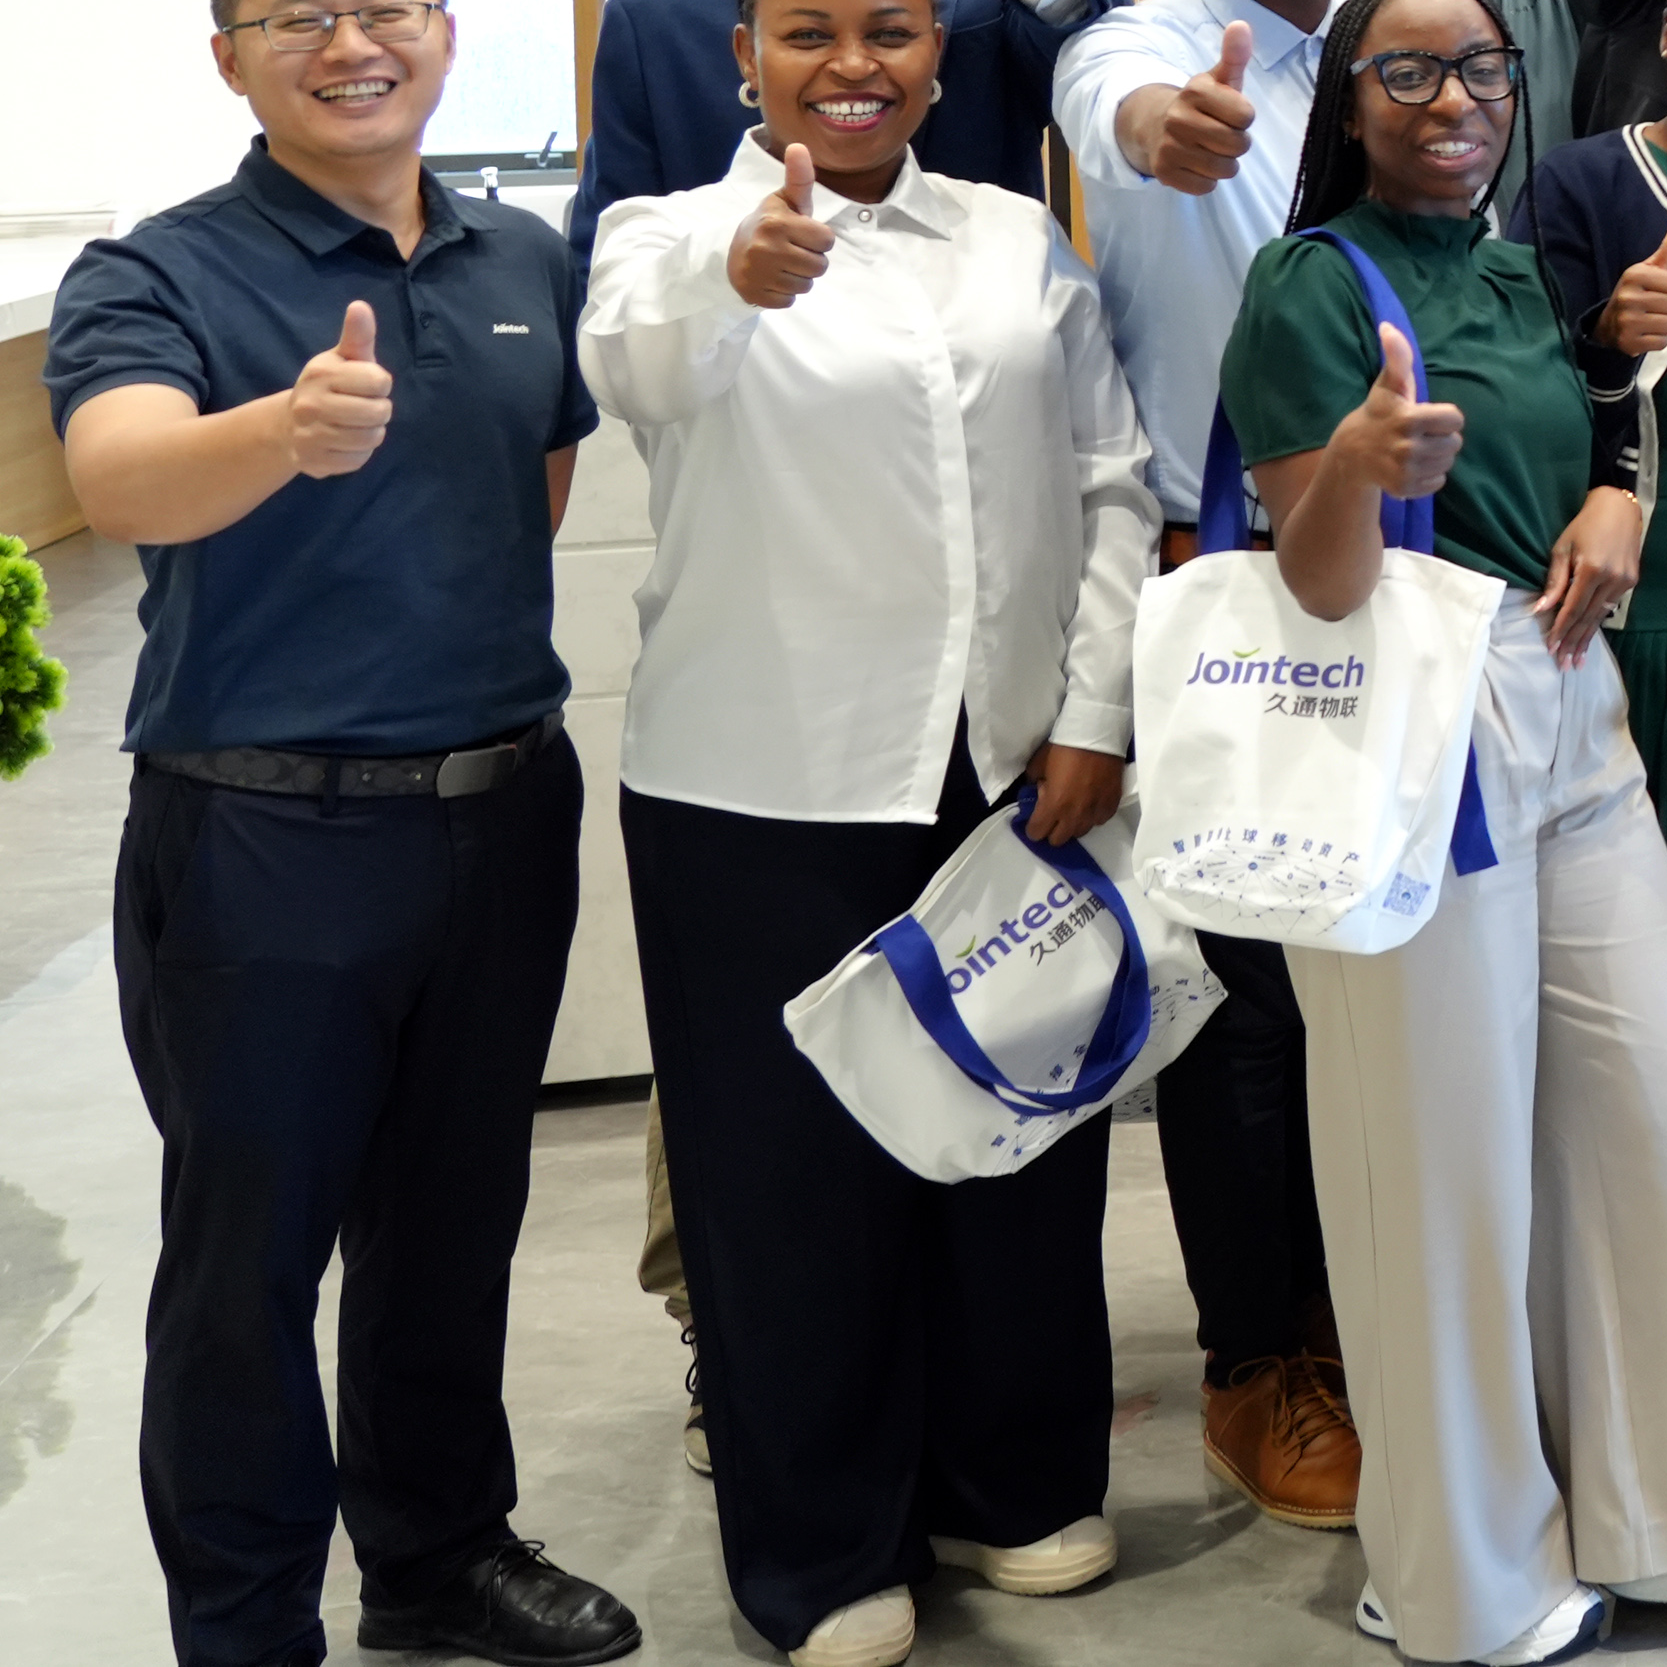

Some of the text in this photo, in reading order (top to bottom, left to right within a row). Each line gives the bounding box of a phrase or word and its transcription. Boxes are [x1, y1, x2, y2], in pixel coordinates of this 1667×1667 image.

[1186, 648, 1364, 688] Jointech
[1264, 692, 1358, 719] 久通物联
[945, 881, 1086, 995] ointec
